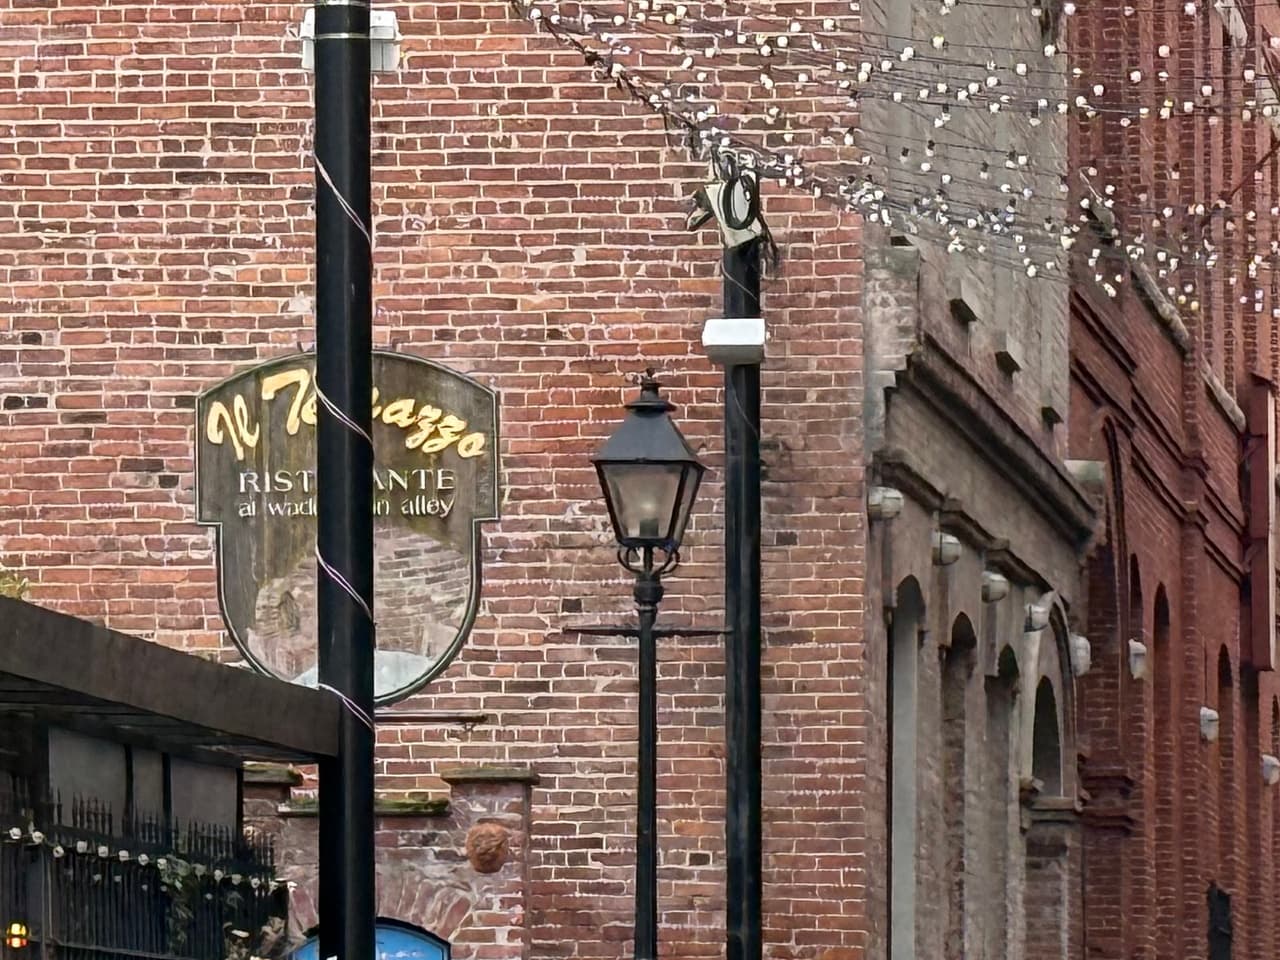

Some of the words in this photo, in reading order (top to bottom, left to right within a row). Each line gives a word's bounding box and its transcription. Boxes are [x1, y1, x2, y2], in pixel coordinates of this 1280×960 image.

[207, 394, 260, 461] Il
[262, 368, 486, 458] Teazzo
[240, 468, 456, 493] RISTANTE
[401, 494, 456, 519] alley
